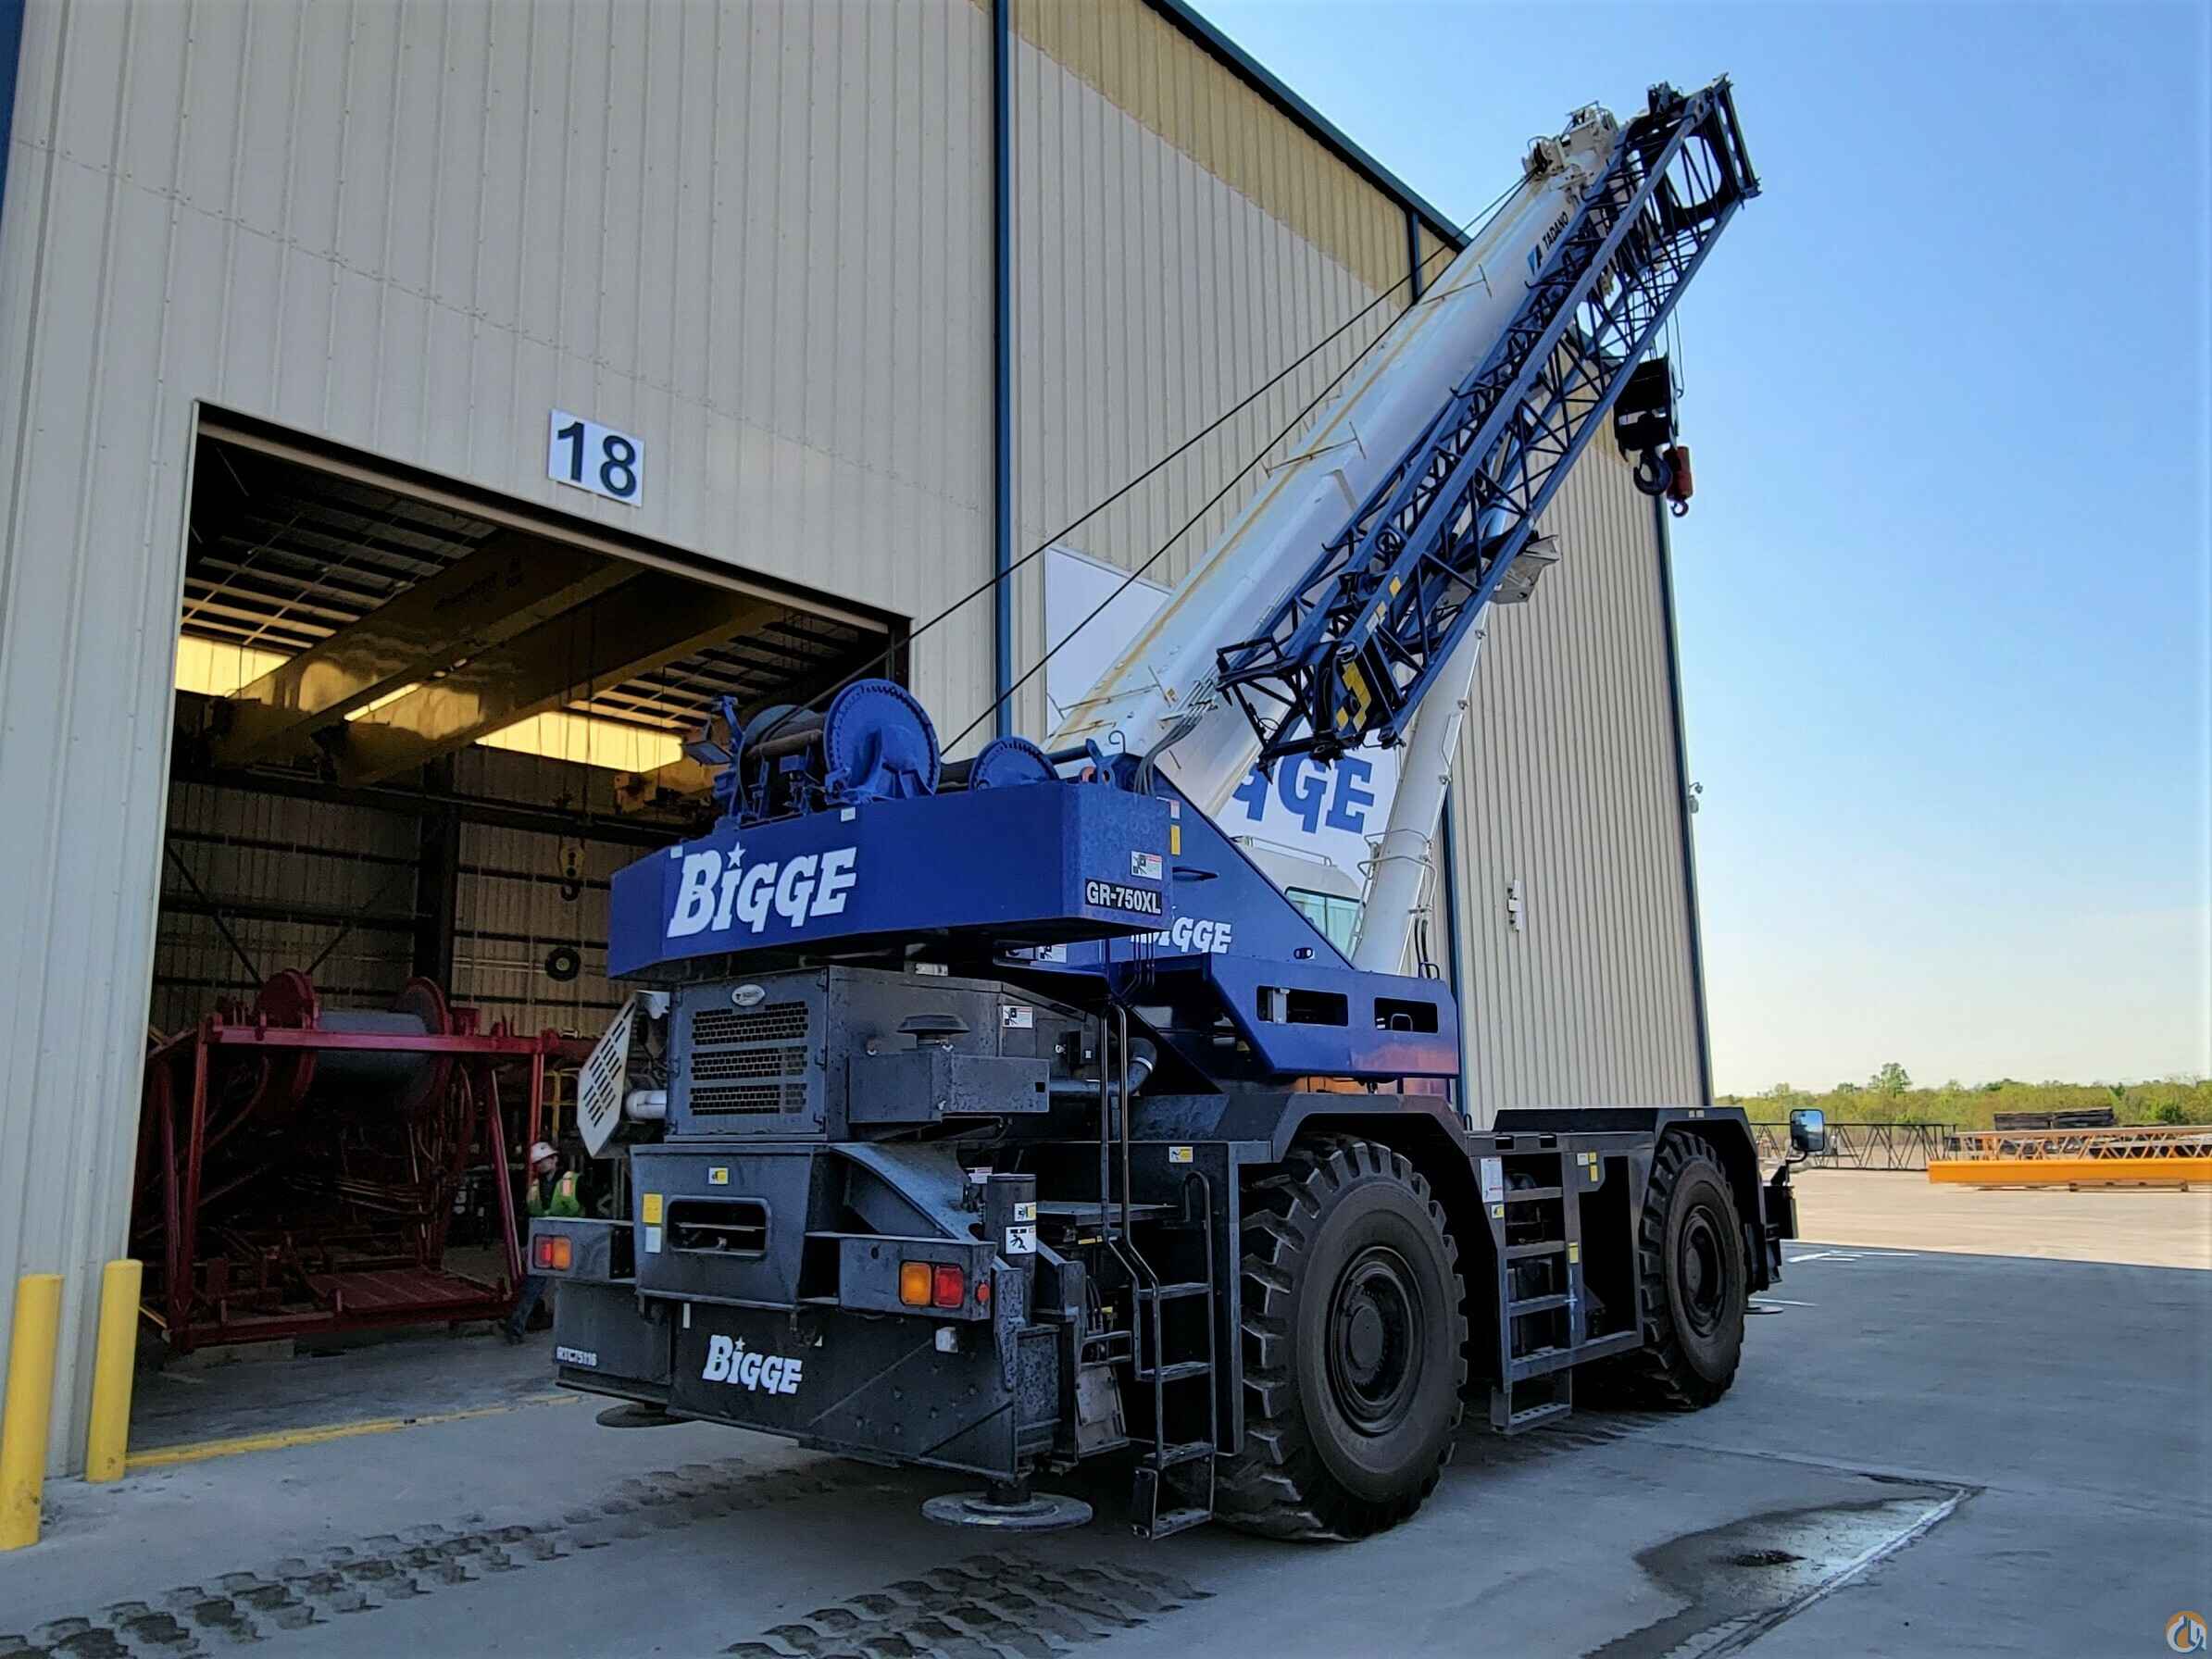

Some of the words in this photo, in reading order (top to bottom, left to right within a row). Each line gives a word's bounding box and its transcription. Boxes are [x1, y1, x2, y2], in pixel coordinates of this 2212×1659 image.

[1542, 211, 1569, 251] TADANO
[557, 421, 637, 497] 18
[1086, 881, 1162, 915] GR-750XL
